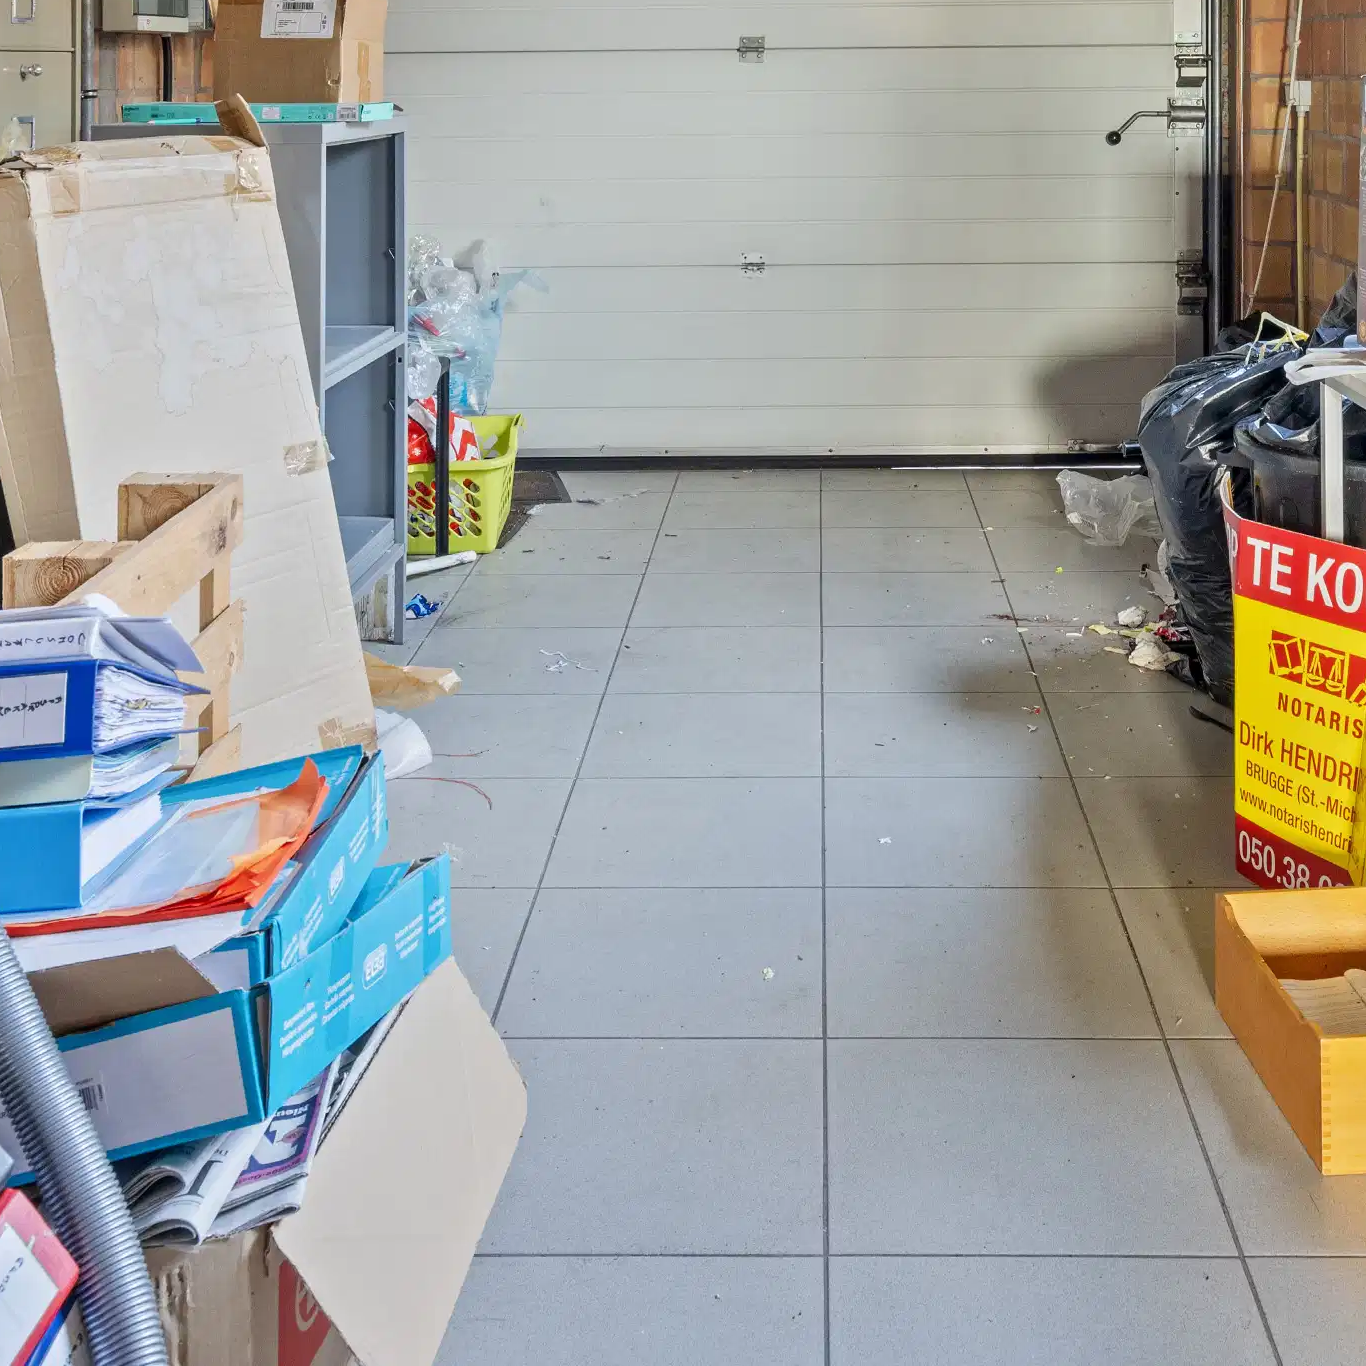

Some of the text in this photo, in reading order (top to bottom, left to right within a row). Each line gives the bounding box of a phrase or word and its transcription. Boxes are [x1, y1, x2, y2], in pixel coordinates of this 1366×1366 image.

[1246, 536, 1294, 596] TE
[1277, 692, 1364, 739] NOTARIS
[1239, 720, 1362, 793] Dirk HENDRI
[1246, 759, 1294, 798] BRUGGE
[1238, 830, 1346, 890] 050.38
[272, 1103, 309, 1117] Nieu
